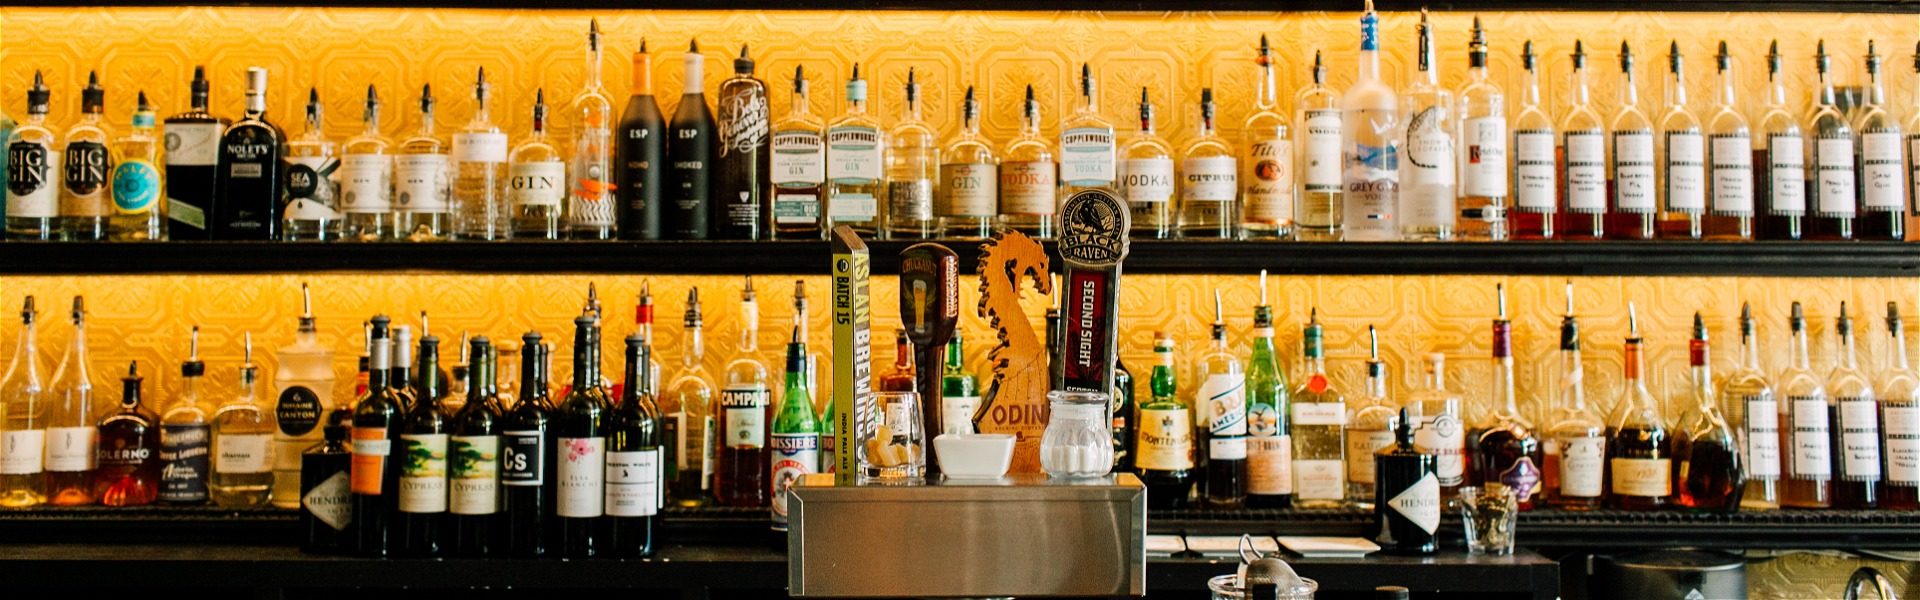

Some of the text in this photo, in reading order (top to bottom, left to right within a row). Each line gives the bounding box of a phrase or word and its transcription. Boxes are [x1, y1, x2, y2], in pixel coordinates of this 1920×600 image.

[630, 129, 648, 139] ESP
[679, 129, 697, 139] ESP
[831, 132, 875, 142] COPPERWORKS
[1065, 134, 1110, 144] COPPERWORKS
[774, 136, 819, 146] COPPERWORKS
[10, 149, 42, 166] BIG
[69, 149, 104, 166] BIG
[789, 166, 804, 175] GIN
[845, 162, 859, 171] GIN
[1075, 164, 1102, 173] VODKA
[9, 165, 43, 183] GIN
[67, 165, 104, 182] GIN
[290, 172, 310, 184] SEA
[1003, 173, 1050, 185] VODKA
[1188, 173, 1235, 182] CITRUS
[512, 176, 554, 190] GIN
[952, 176, 981, 190] GIN
[1122, 174, 1169, 187] VODKA
[1064, 234, 1122, 255] BLACK
[1073, 246, 1108, 259] RAVEN
[854, 252, 871, 325] ASLAN
[836, 276, 850, 326] BATCH 15
[1079, 280, 1095, 367] SECOND SIGHT
[722, 391, 770, 407] CAMPARI
[280, 411, 315, 419] CANTON
[992, 404, 1046, 426] ODIN
[504, 447, 527, 471] Cs
